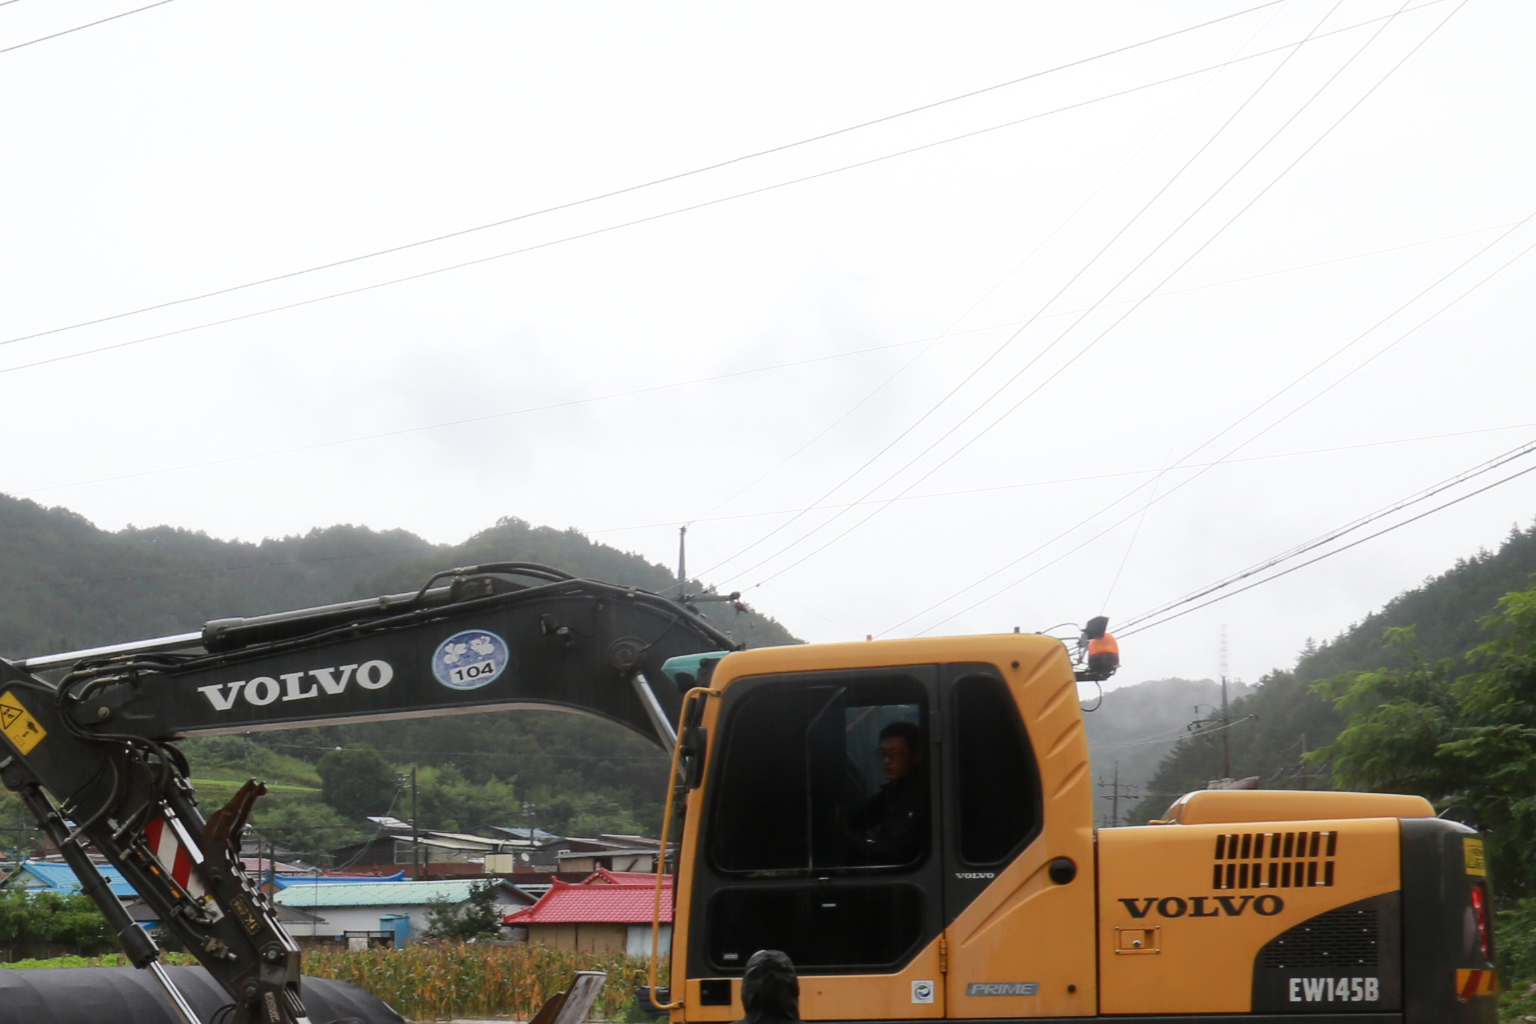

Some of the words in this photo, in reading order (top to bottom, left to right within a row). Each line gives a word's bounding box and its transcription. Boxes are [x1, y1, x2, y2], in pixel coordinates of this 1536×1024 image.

[454, 662, 494, 681] 104
[197, 659, 394, 711] VOLVO
[1118, 894, 1284, 918] VOLVO
[971, 983, 1035, 995] PRIME
[1288, 977, 1379, 1002] EW145B
